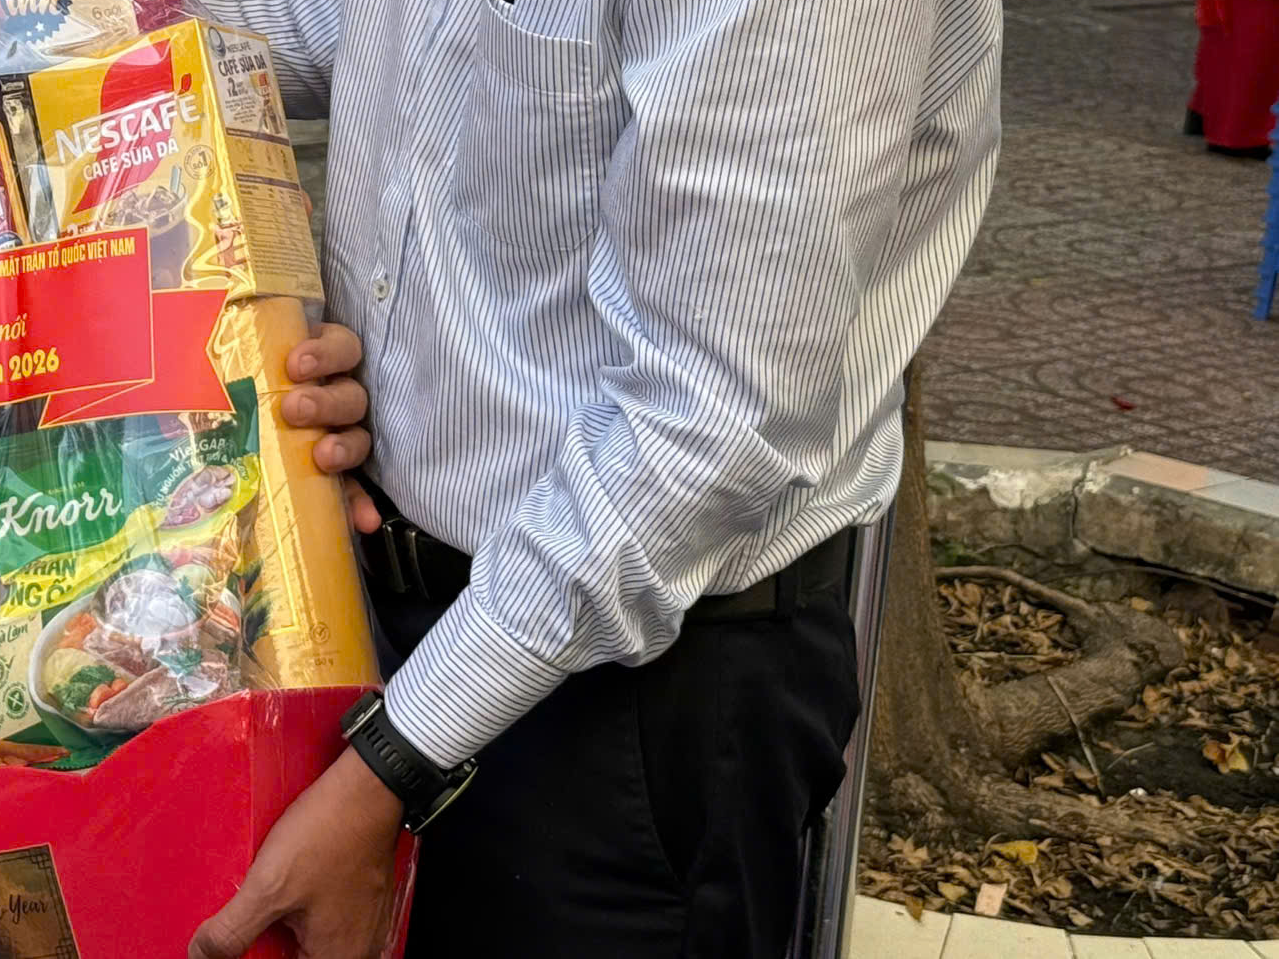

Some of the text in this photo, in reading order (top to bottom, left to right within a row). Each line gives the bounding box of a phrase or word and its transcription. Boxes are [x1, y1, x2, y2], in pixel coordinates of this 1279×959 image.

[55, 73, 201, 162] NESCAFÉ
[83, 153, 119, 181] CAFÉ
[0, 256, 21, 281] MẶT
[22, 251, 46, 277] TRẬN
[47, 241, 60, 268] TỔ
[61, 240, 86, 266] QUỐC
[87, 238, 109, 264] VIỆT
[110, 237, 135, 257] NAM
[8, 347, 60, 382] 2026
[9, 894, 49, 924] Year
